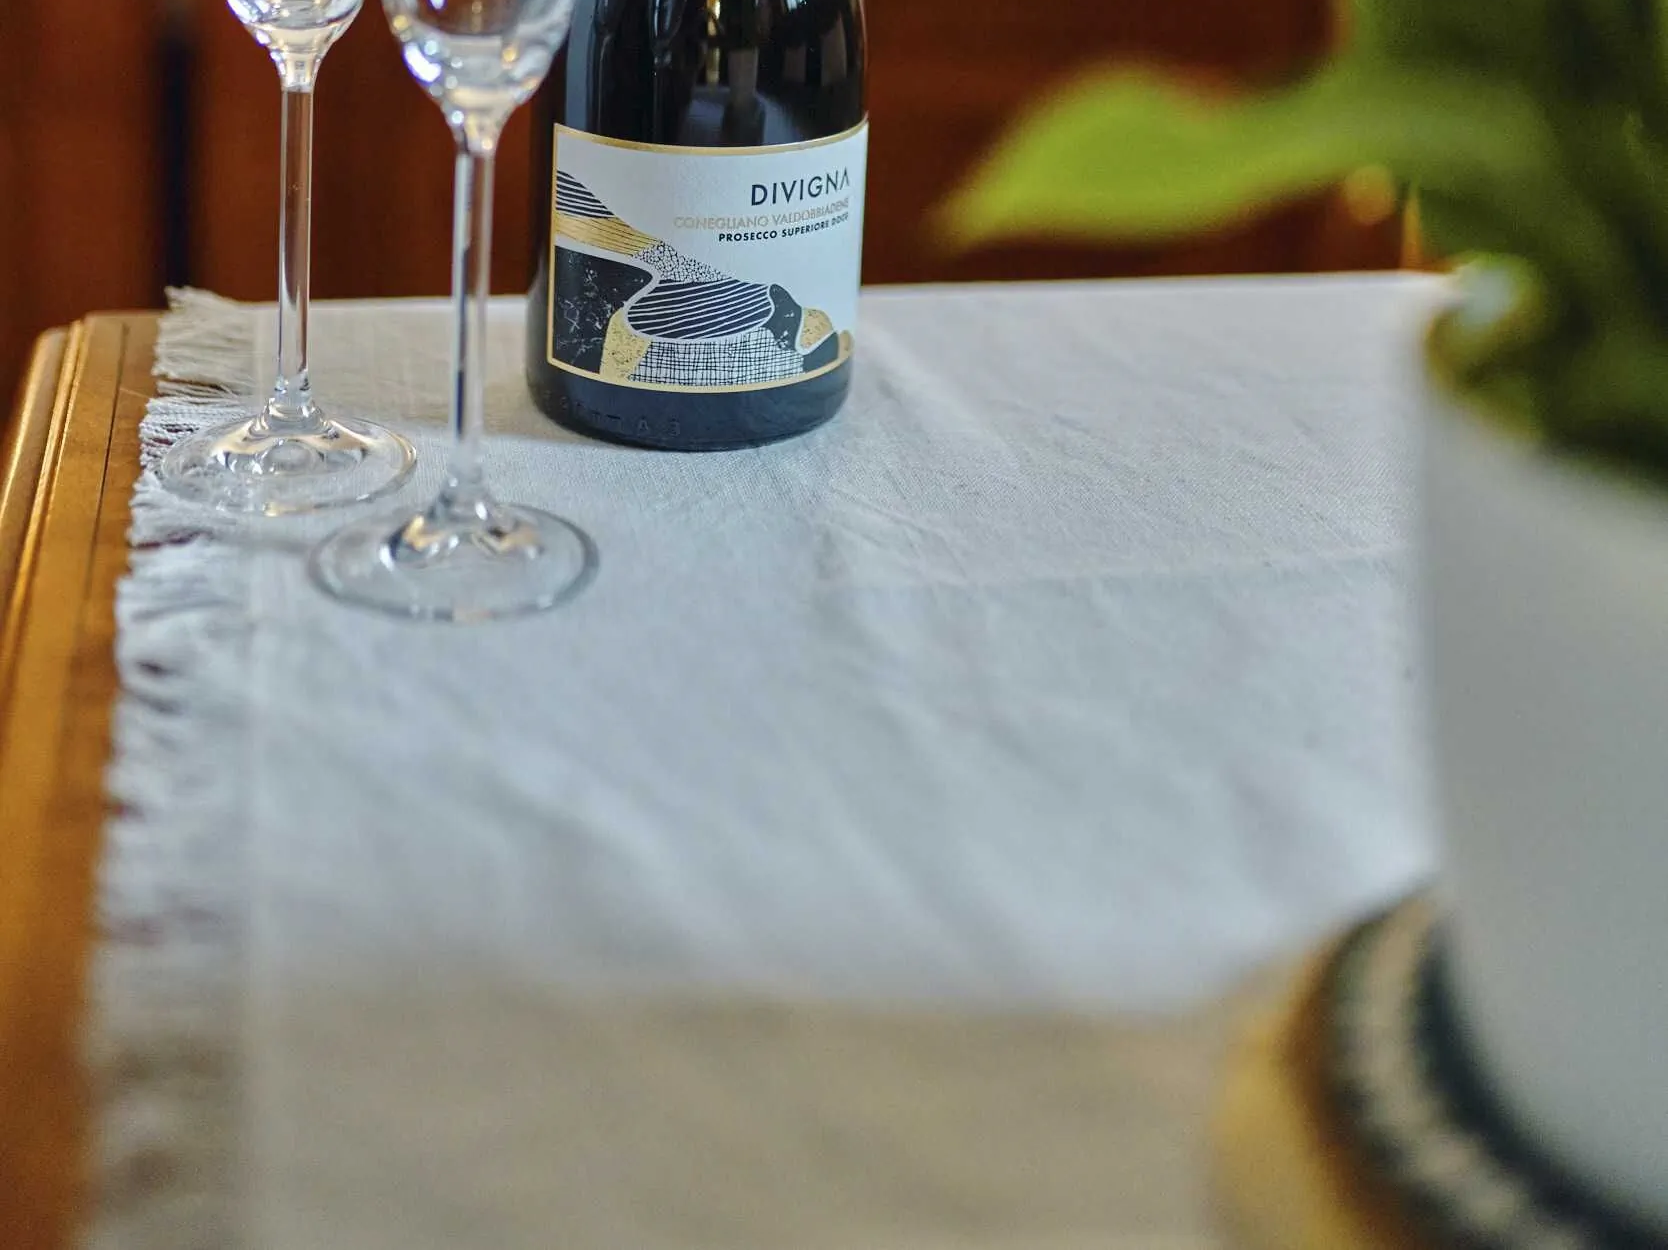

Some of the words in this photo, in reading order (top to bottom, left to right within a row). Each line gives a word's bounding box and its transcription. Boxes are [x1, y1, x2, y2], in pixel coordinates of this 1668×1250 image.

[751, 166, 850, 206] DIVIGNA
[673, 214, 769, 230] CONEGLIANO
[718, 230, 778, 242] PROSECCO
[781, 220, 829, 238] SUPERIORE
